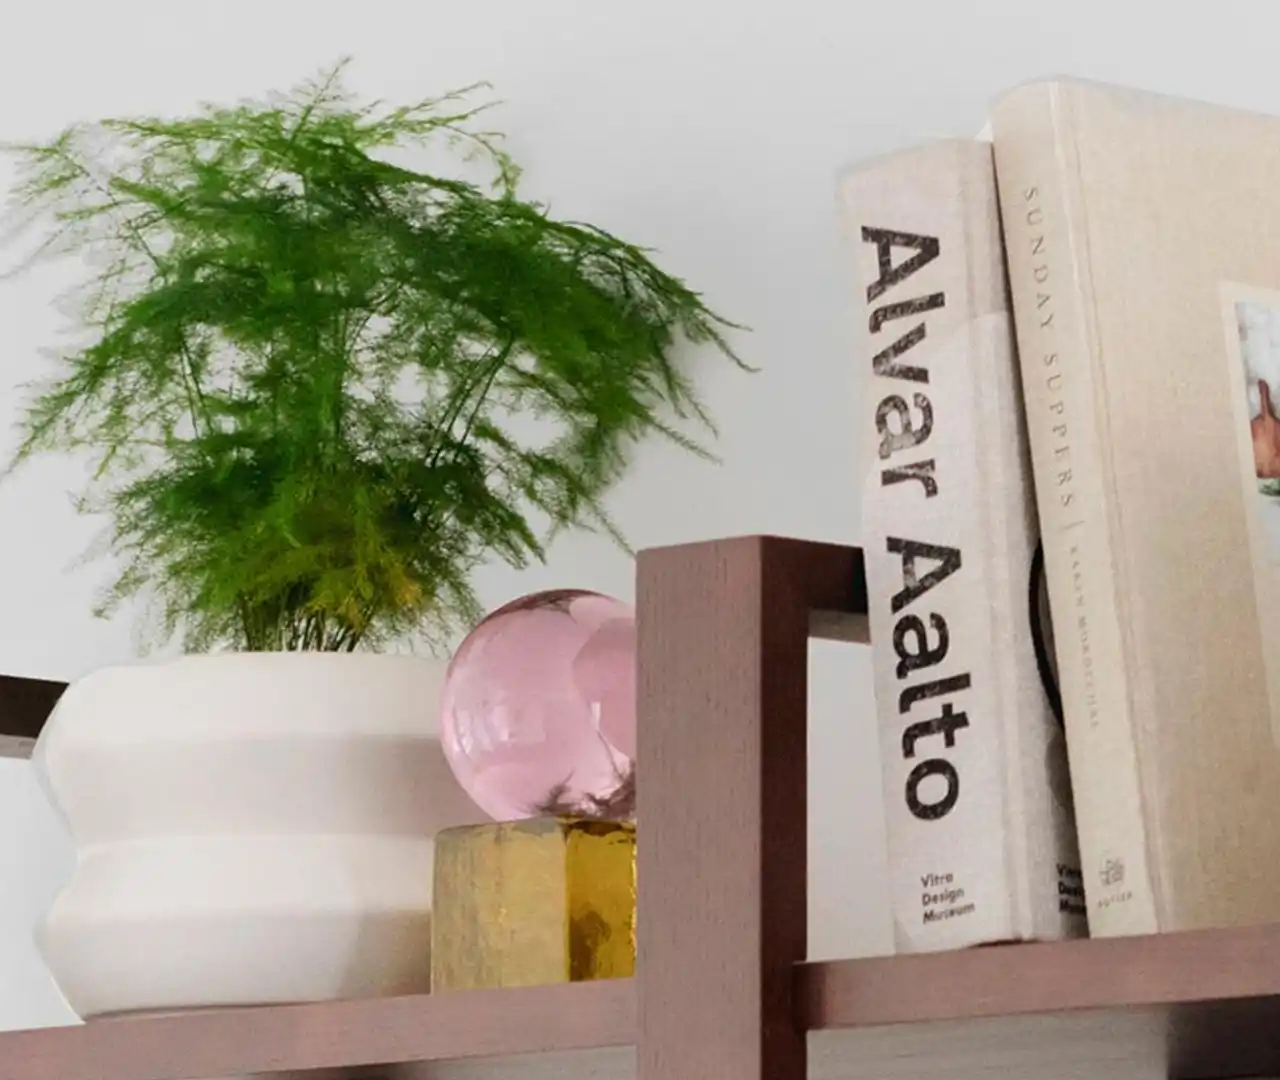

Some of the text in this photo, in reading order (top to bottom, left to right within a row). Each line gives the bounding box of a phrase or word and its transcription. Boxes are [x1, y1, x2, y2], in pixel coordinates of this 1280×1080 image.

[1023, 185, 1055, 330] SUNDAY
[1043, 353, 1076, 508] SUPPERS
[861, 225, 971, 821] Alvar Aalto
[920, 872, 954, 888] Vitra
[922, 886, 966, 907] Design
[922, 902, 976, 925] Museum
